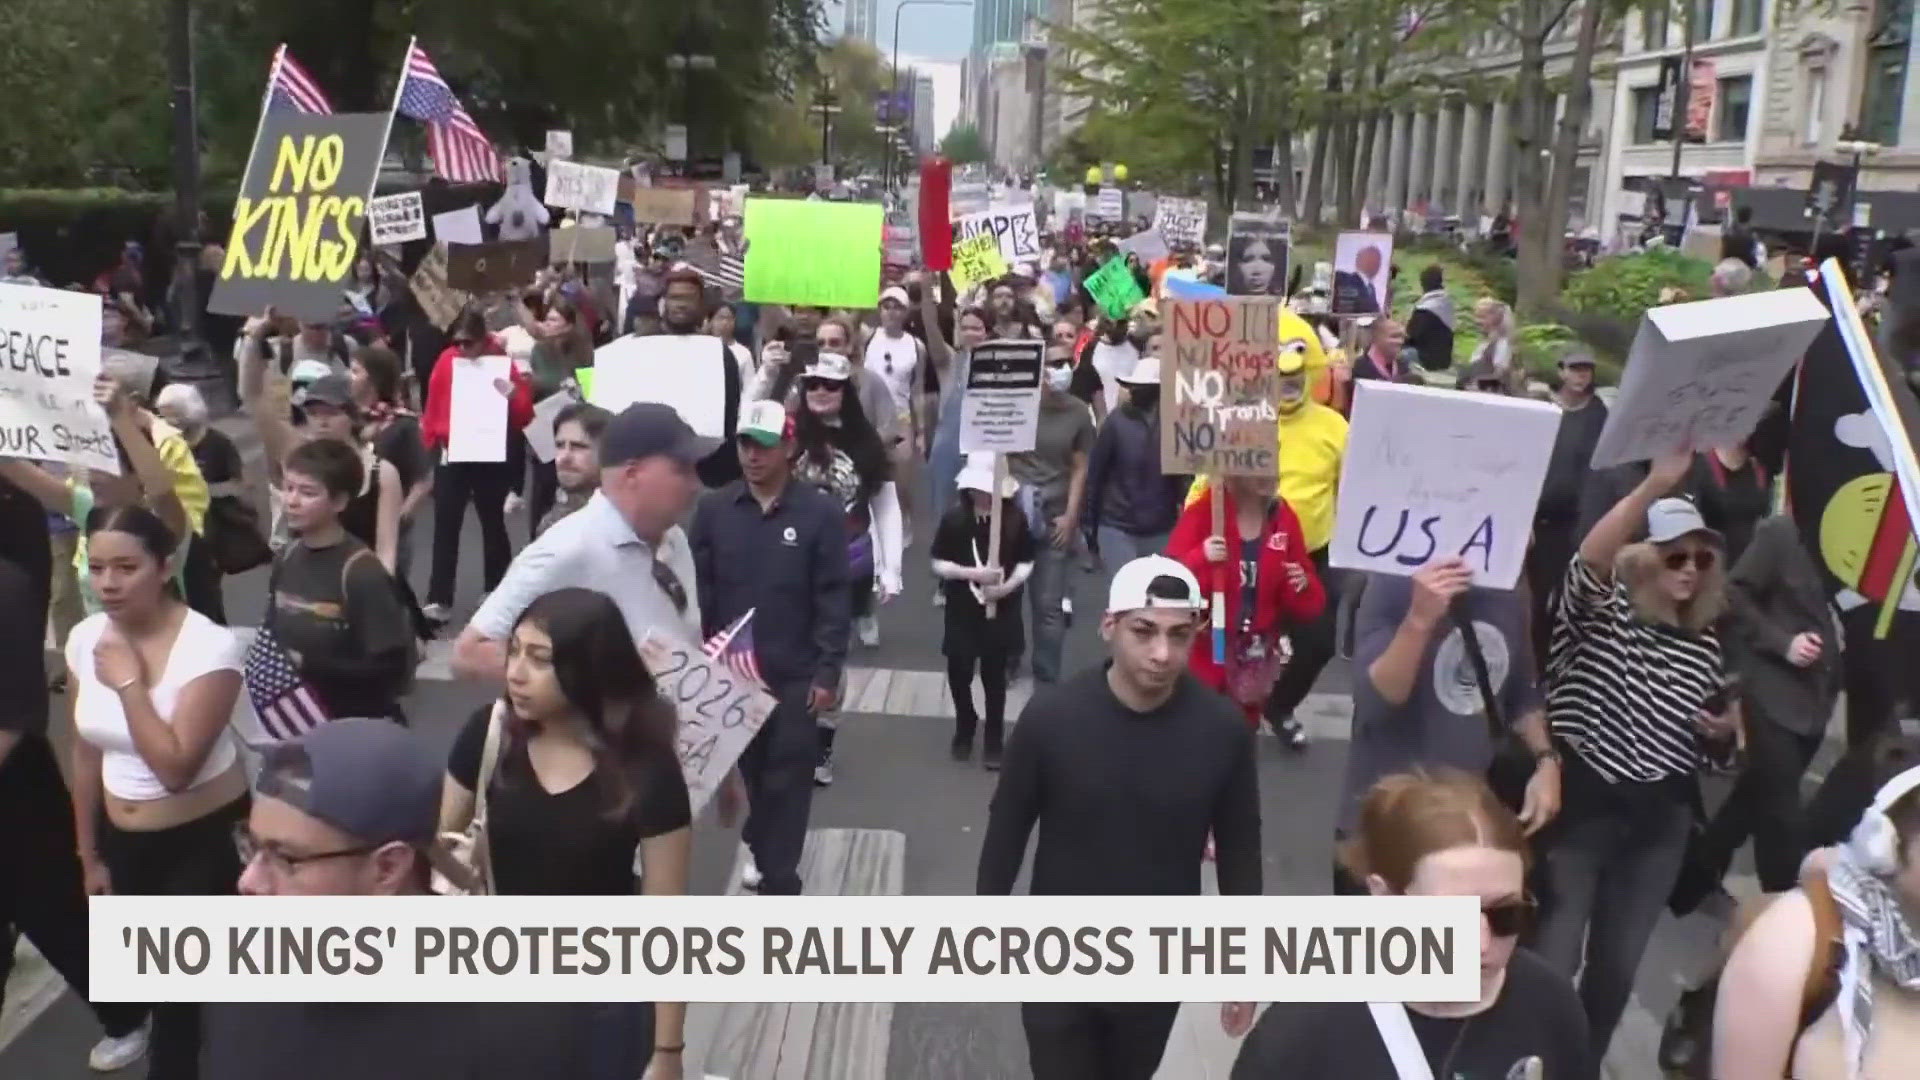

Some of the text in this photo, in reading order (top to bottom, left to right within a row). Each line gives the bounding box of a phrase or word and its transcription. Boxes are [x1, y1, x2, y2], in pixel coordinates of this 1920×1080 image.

[269, 134, 344, 193] NO
[221, 195, 364, 281] KINGS
[1172, 302, 1231, 342] NO
[0, 327, 71, 378] PEACE
[1175, 370, 1224, 404] NO
[1173, 422, 1215, 456] NO
[1357, 505, 1493, 573] USA
[655, 651, 753, 729] 2026
